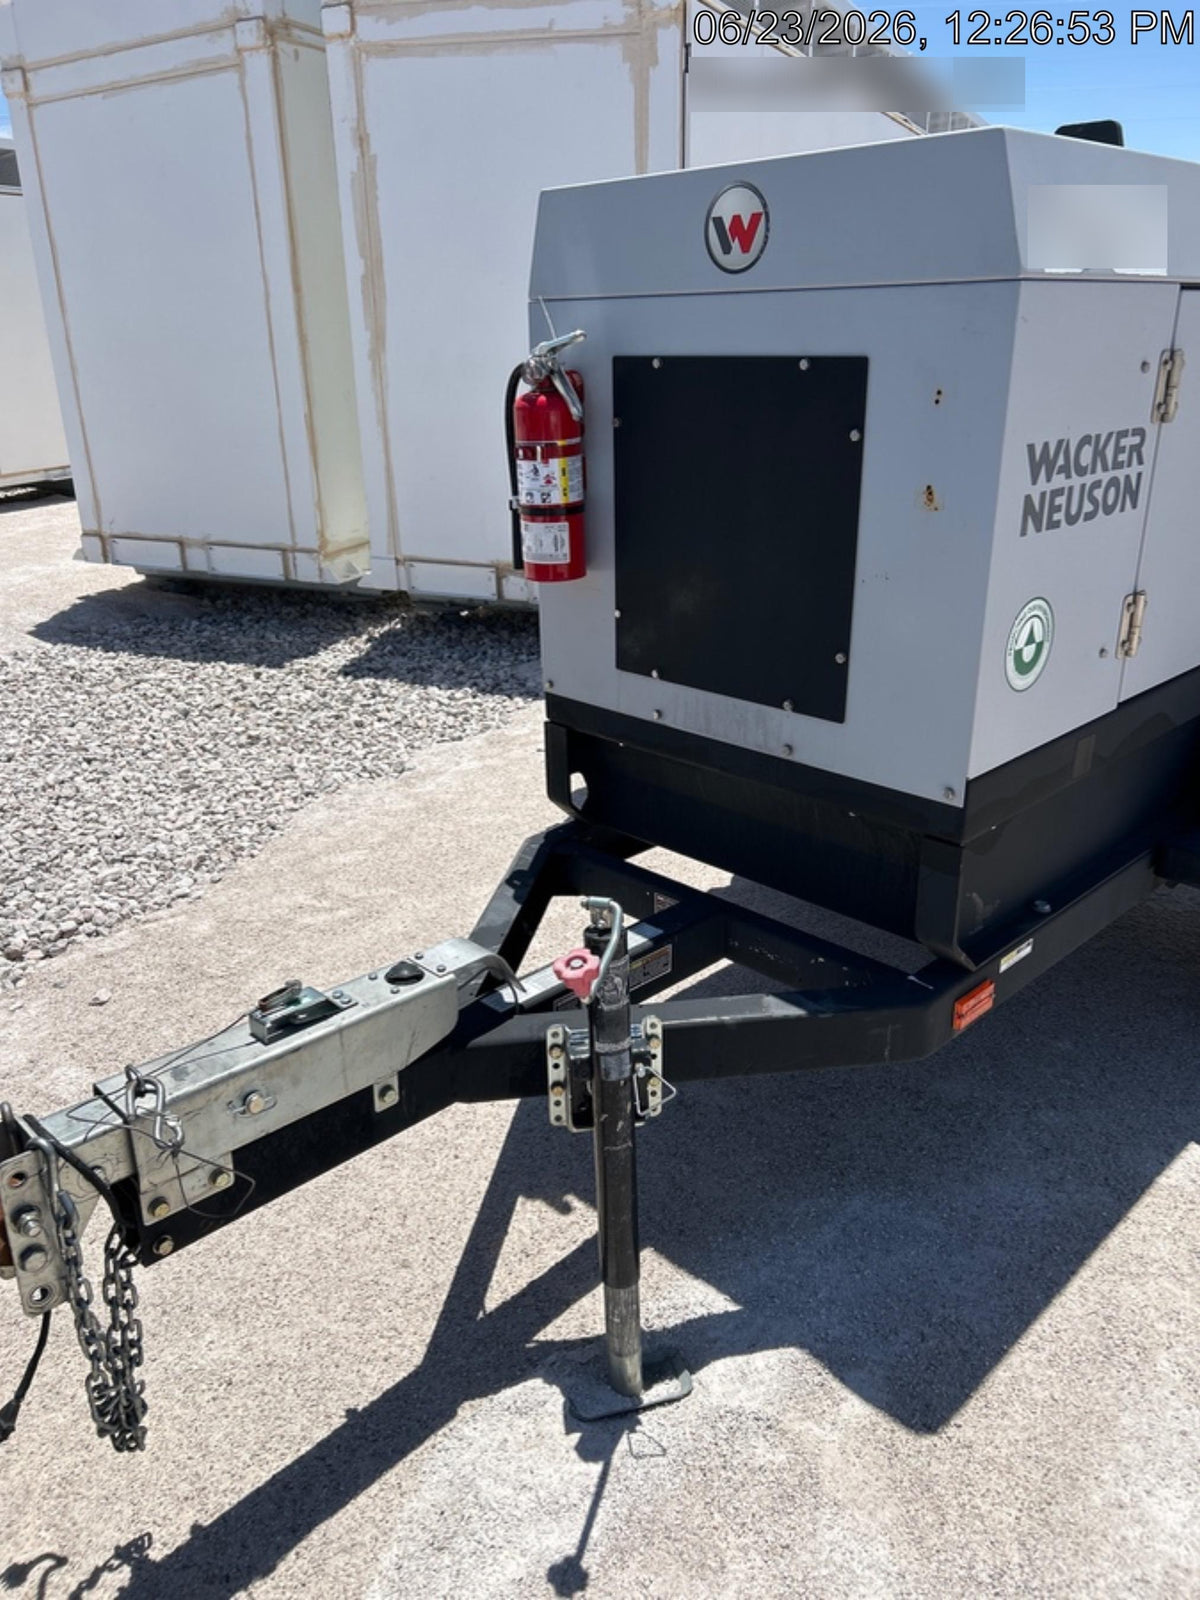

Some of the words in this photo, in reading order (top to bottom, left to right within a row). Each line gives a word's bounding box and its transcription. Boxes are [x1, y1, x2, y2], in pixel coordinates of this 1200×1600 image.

[712, 212, 764, 255] W
[1026, 427, 1147, 486] WACKER
[1020, 472, 1143, 537] NEUSON
